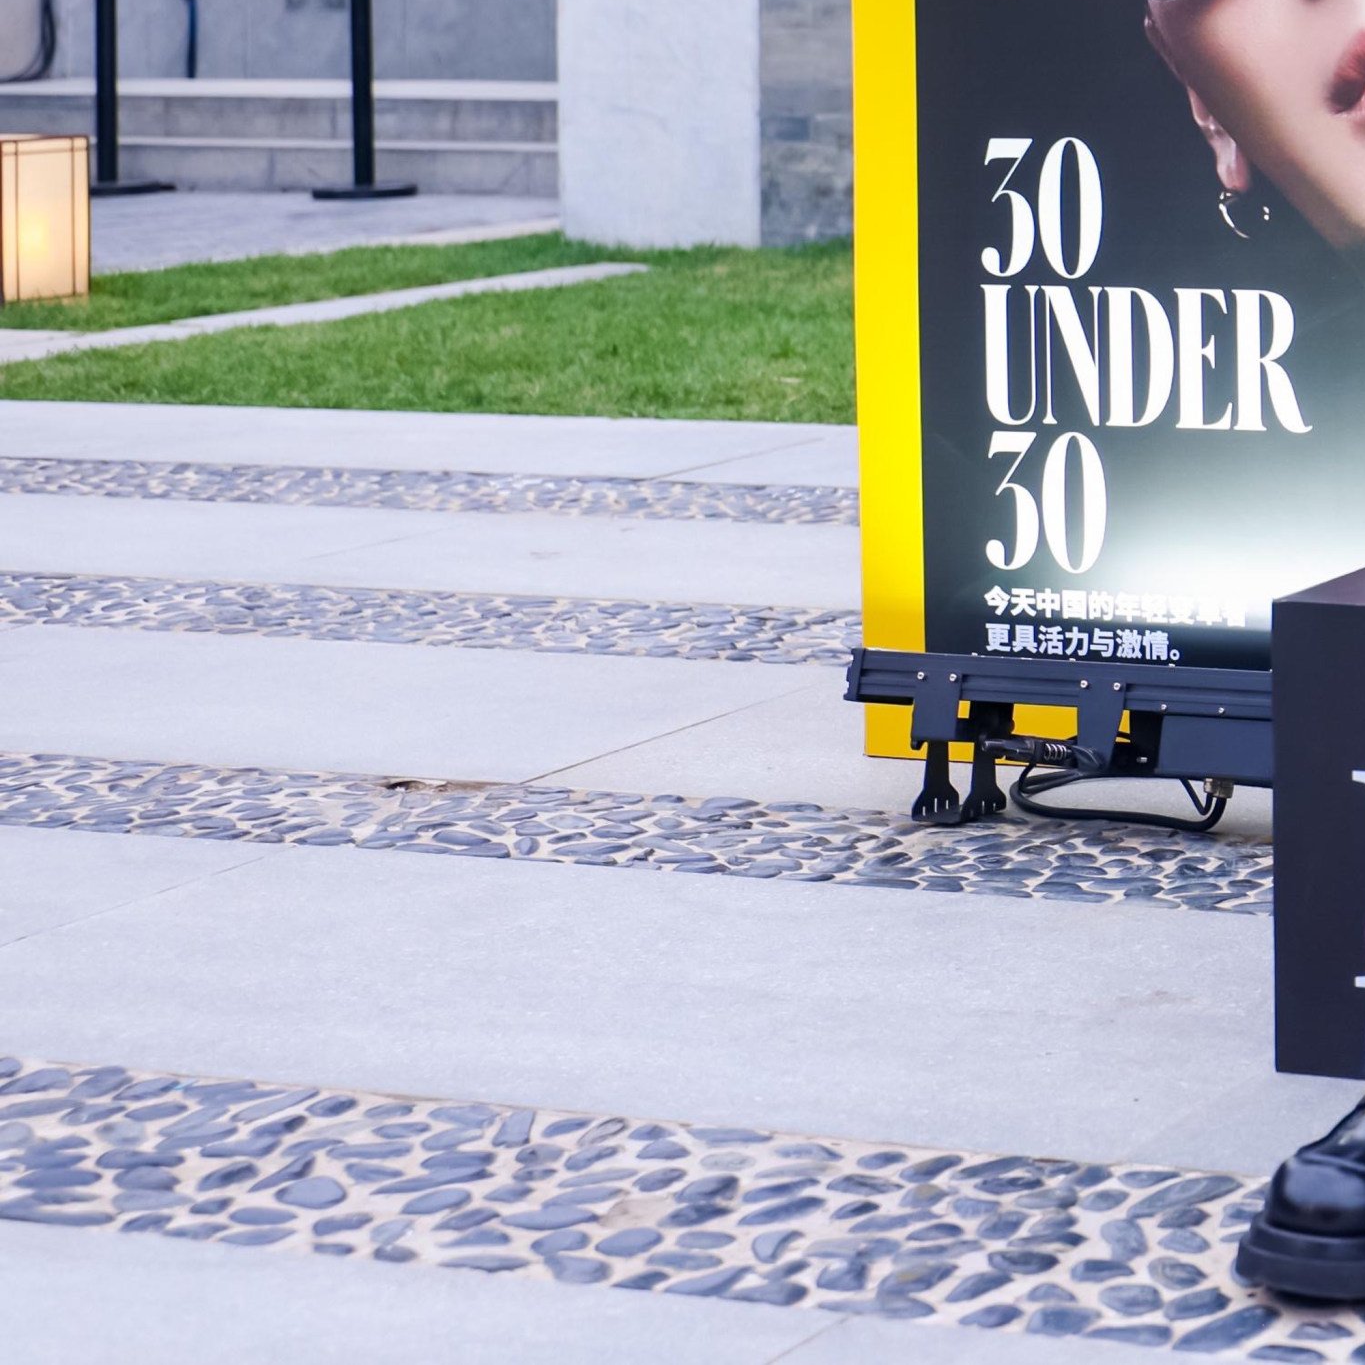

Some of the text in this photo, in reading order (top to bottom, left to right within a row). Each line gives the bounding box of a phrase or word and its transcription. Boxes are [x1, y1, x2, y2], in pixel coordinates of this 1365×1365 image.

[981, 136, 1103, 279] 30
[980, 283, 1314, 435] UNDER
[985, 431, 1108, 575] 30
[985, 622, 1181, 661] 更具活力与激情。
